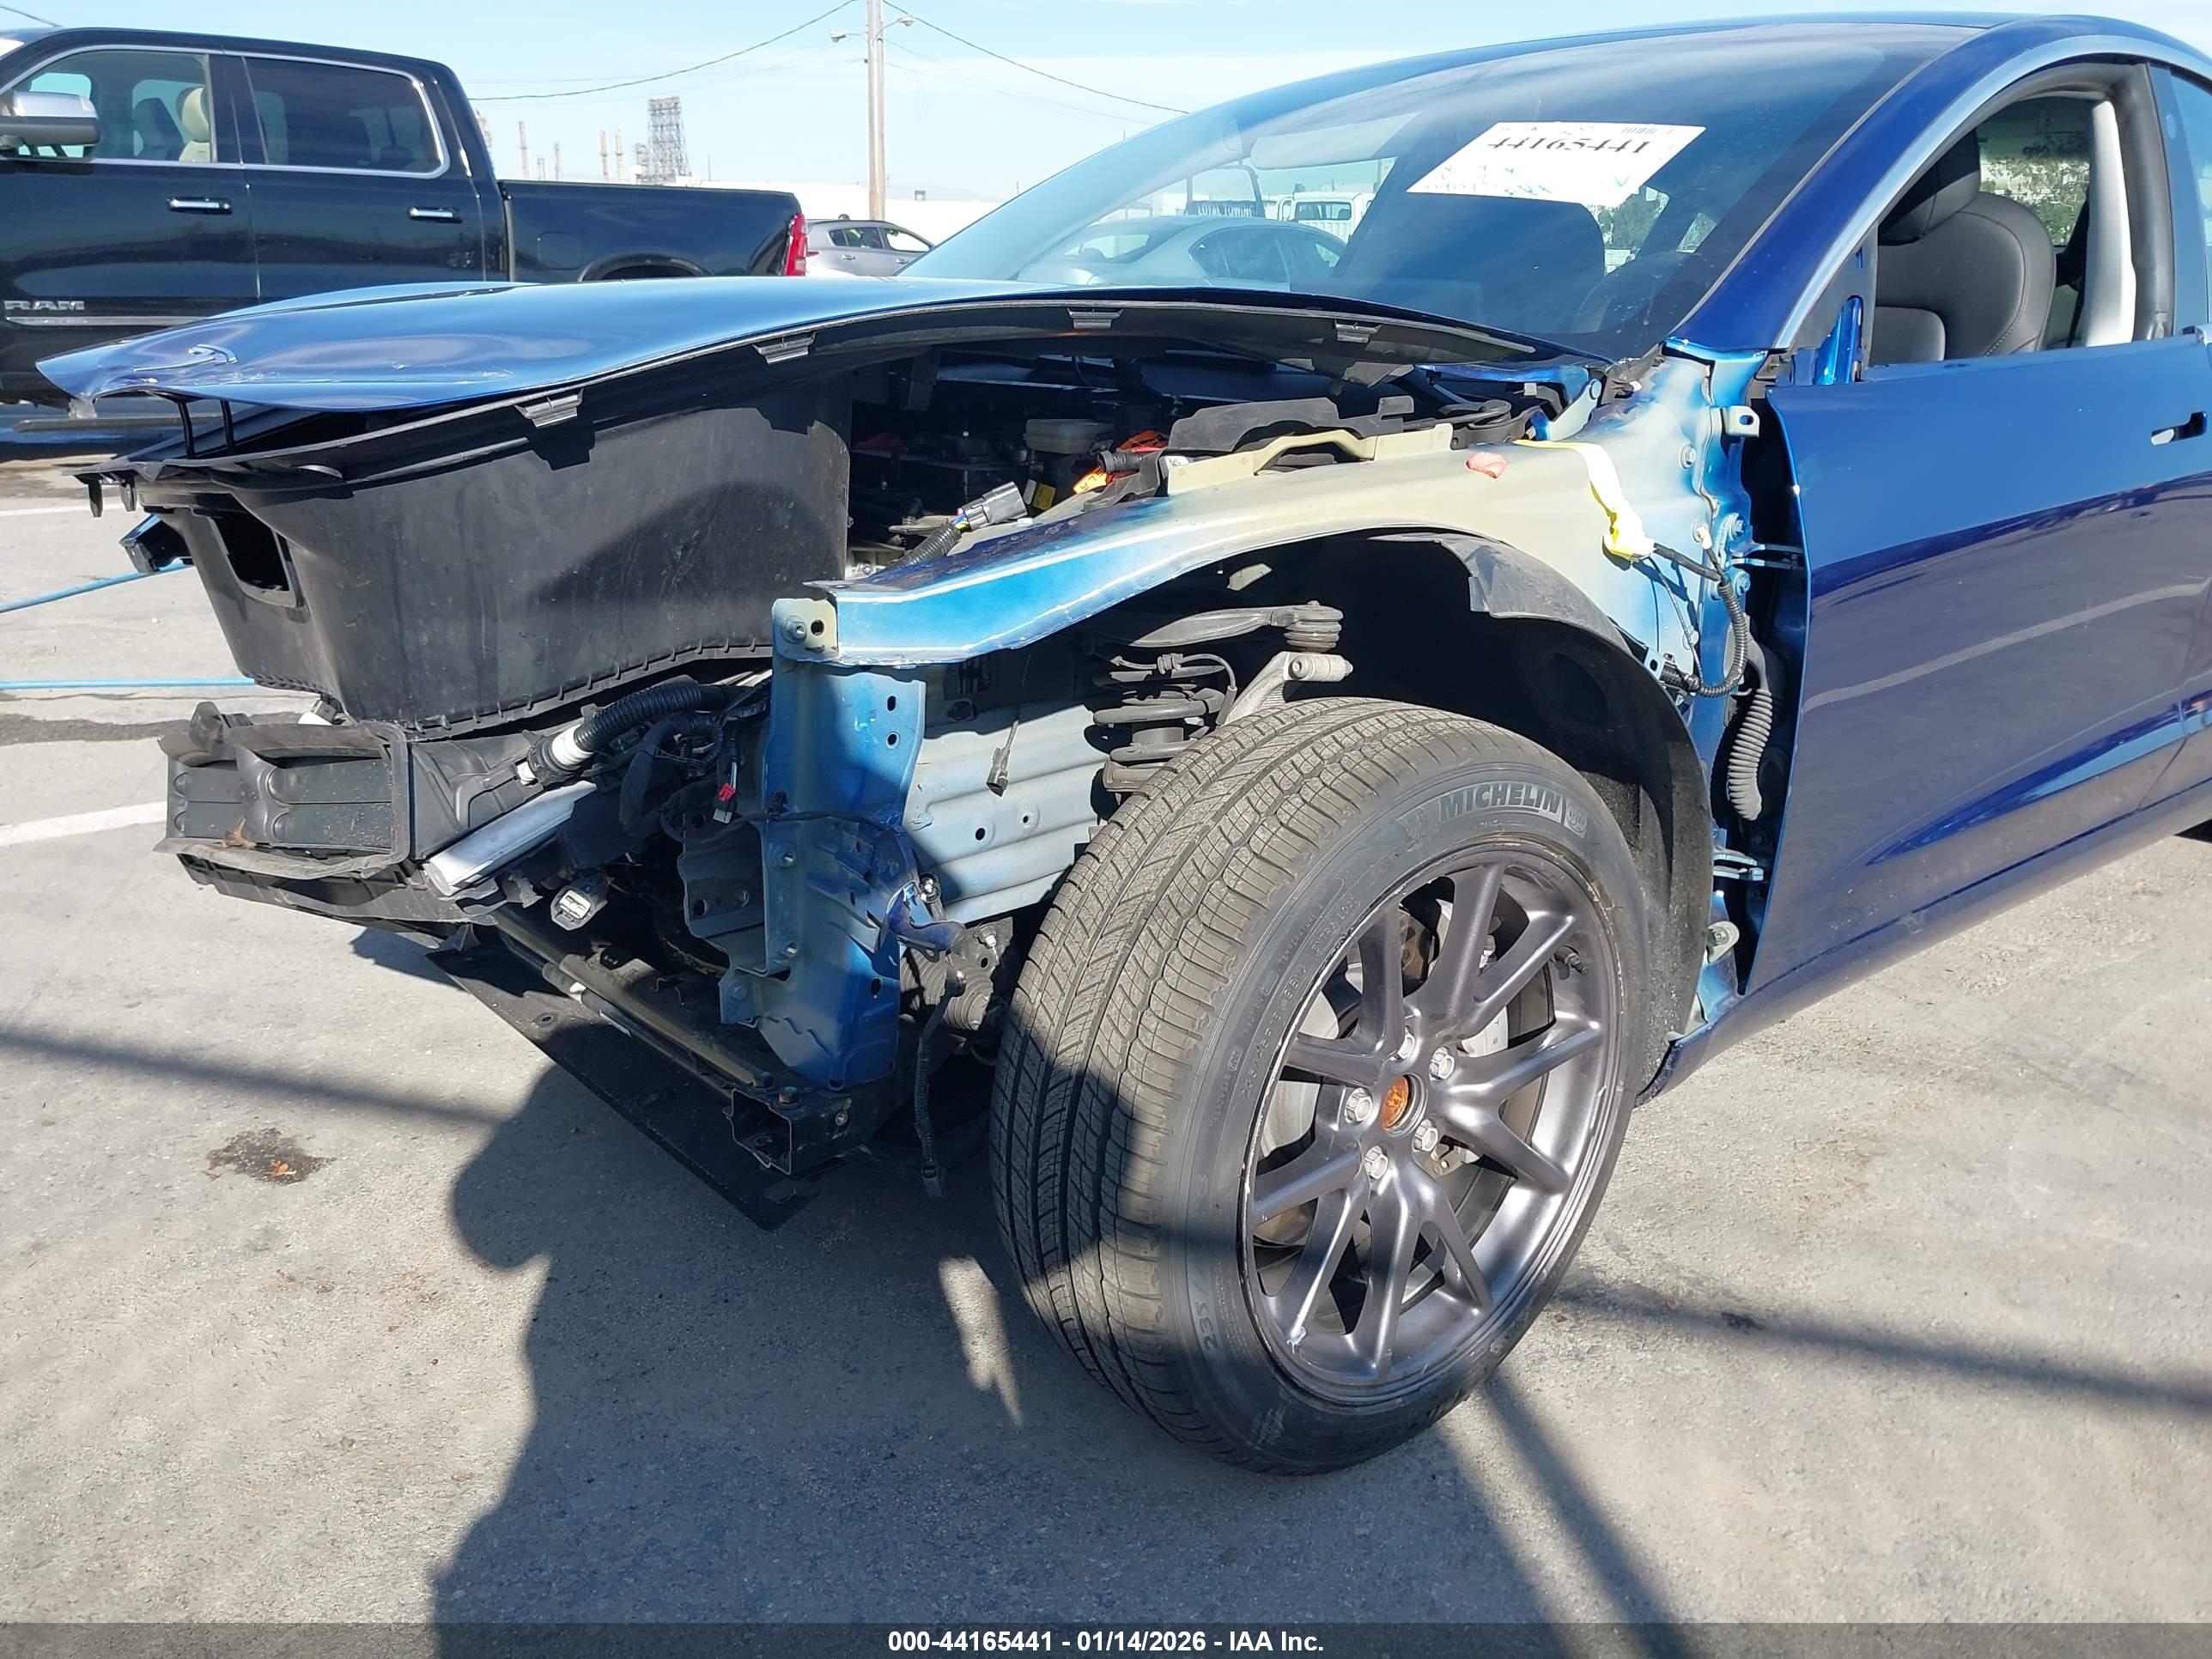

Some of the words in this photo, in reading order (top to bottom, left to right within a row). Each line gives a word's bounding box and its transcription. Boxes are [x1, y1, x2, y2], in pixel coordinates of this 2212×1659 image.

[1488, 137, 1651, 154] 44165441
[3, 300, 85, 311] RAM
[1441, 782, 1564, 818] MICHELIN
